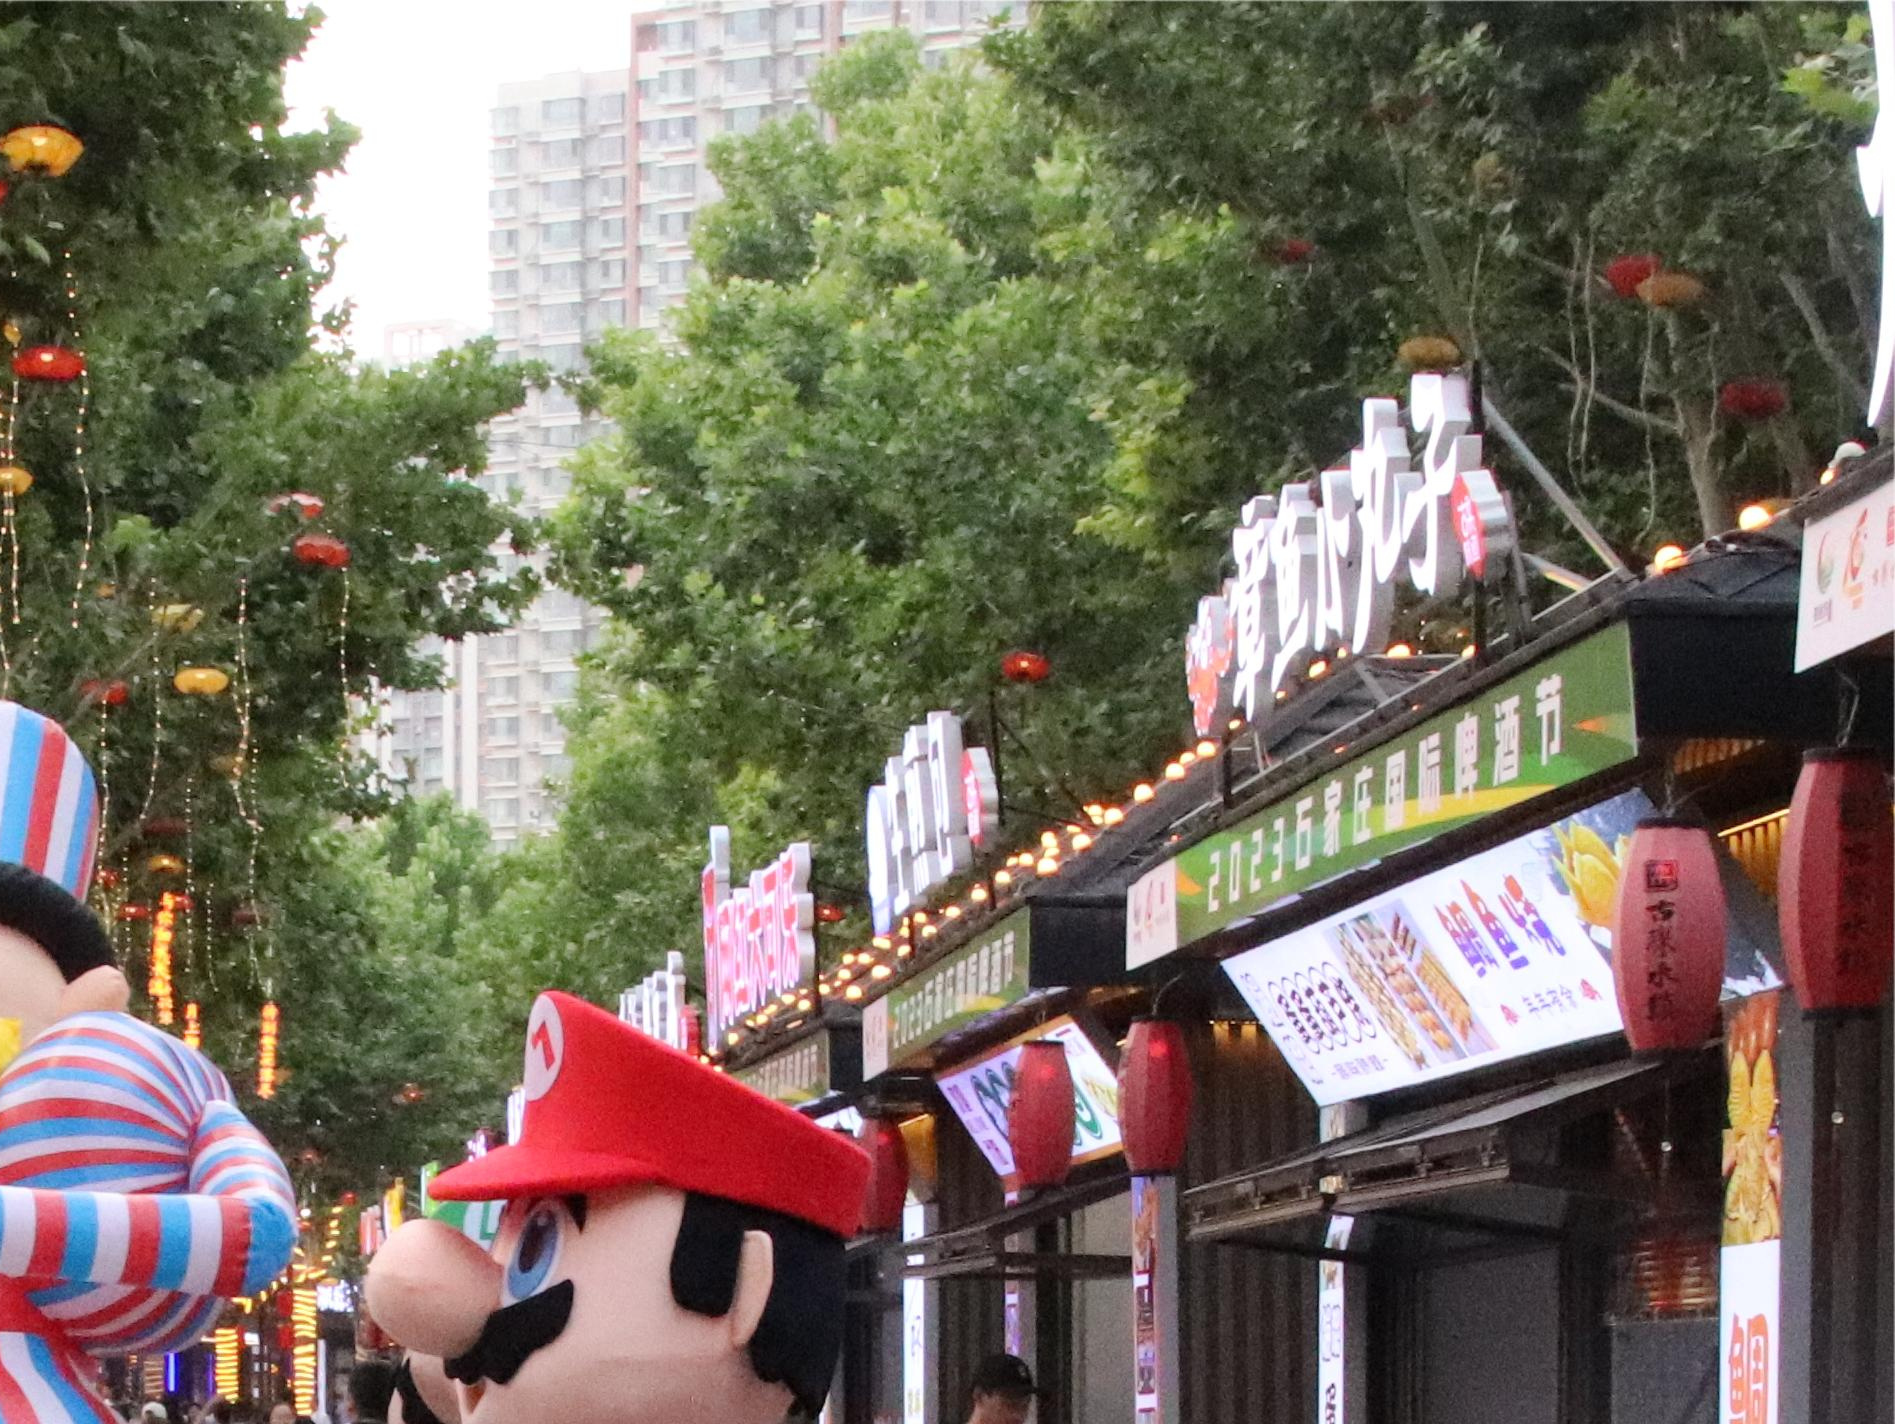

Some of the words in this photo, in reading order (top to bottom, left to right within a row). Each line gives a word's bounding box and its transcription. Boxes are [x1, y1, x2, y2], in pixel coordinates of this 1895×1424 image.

[1207, 673, 1564, 913] 2023石家庄国际啤酒节
[1433, 872, 1567, 979] 鲷鱼烧
